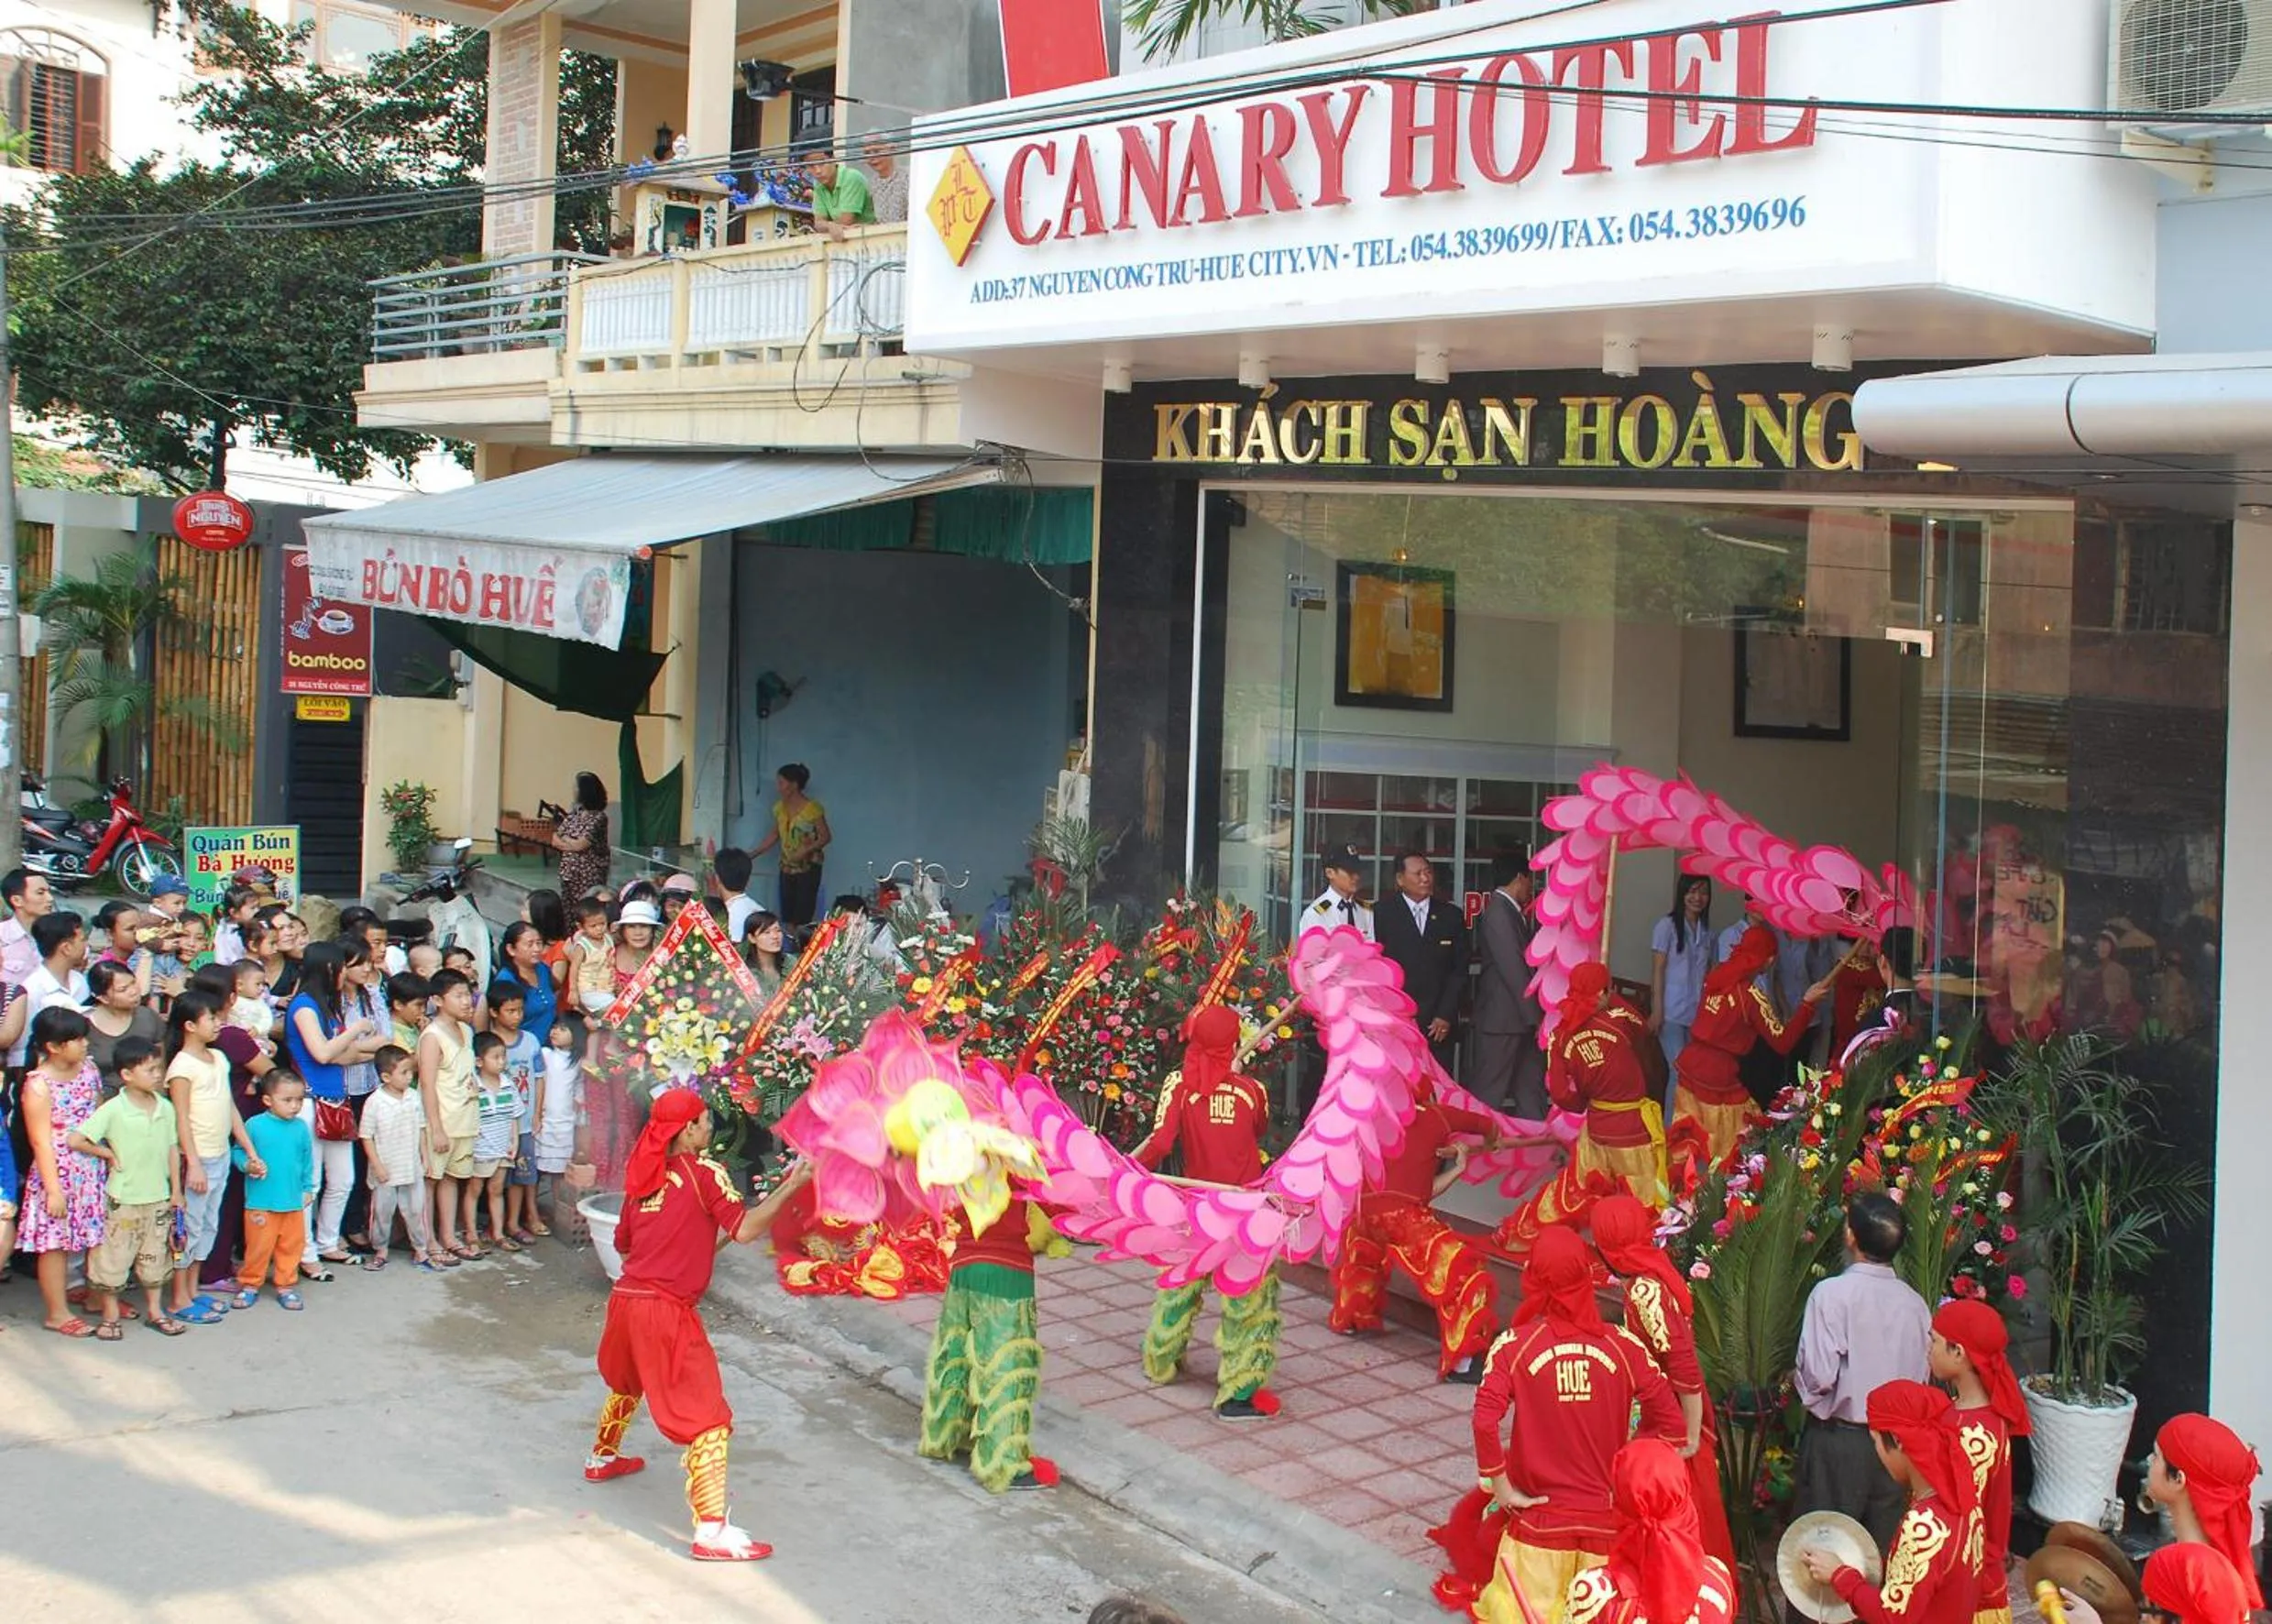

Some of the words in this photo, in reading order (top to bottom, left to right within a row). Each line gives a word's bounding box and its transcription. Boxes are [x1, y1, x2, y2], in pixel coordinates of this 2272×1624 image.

[1004, 84, 1370, 247] CANARY
[1379, 10, 1817, 198] HOTEL
[971, 277, 1027, 304] ADD:37
[1028, 268, 1101, 299] NGUYEN
[1103, 262, 1154, 291] CONG
[1629, 195, 1806, 243] 054.3839696
[1152, 381, 1373, 465] KHÁCH
[1388, 397, 1538, 481] SẠN
[1558, 369, 1865, 471] HOÀNG
[362, 547, 423, 609] BÚN
[425, 555, 473, 616] BÒ
[288, 649, 367, 671] bamboo
[252, 832, 291, 851] Bún
[198, 854, 221, 872] Bà
[1576, 1038, 1604, 1063] HUE
[1209, 1093, 1235, 1118] HUE
[1555, 1360, 1591, 1393] HUE
